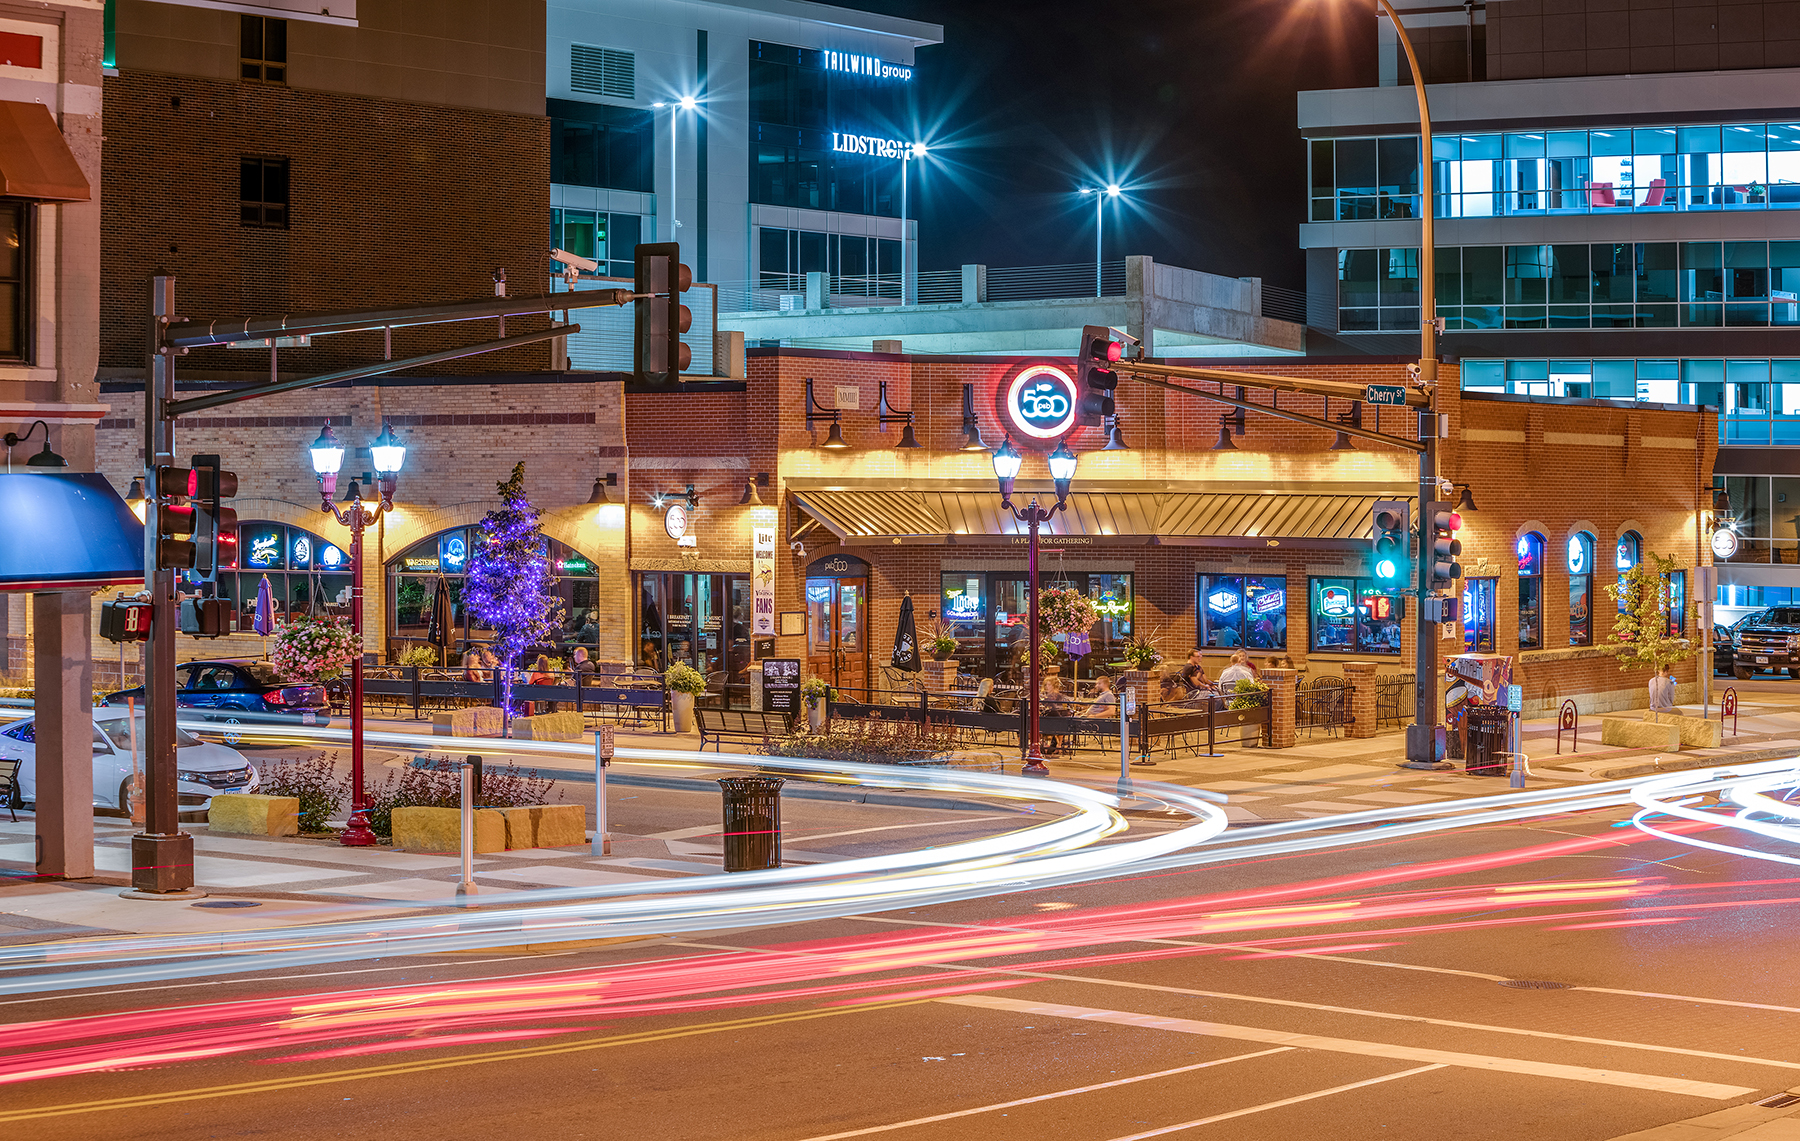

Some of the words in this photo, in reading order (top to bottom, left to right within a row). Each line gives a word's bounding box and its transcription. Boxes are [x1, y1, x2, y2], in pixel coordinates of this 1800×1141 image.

[824, 50, 880, 77] TAILWIND
[882, 65, 912, 81] group
[832, 132, 911, 160] LIDSTROM
[1021, 389, 1069, 418] 500
[1368, 386, 1395, 405] Cherry
[1396, 389, 1403, 397] St
[758, 533, 773, 545] Lite
[1053, 537, 1090, 545] GATHERING
[754, 550, 774, 560] WELCOME
[755, 598, 773, 615] FANS
